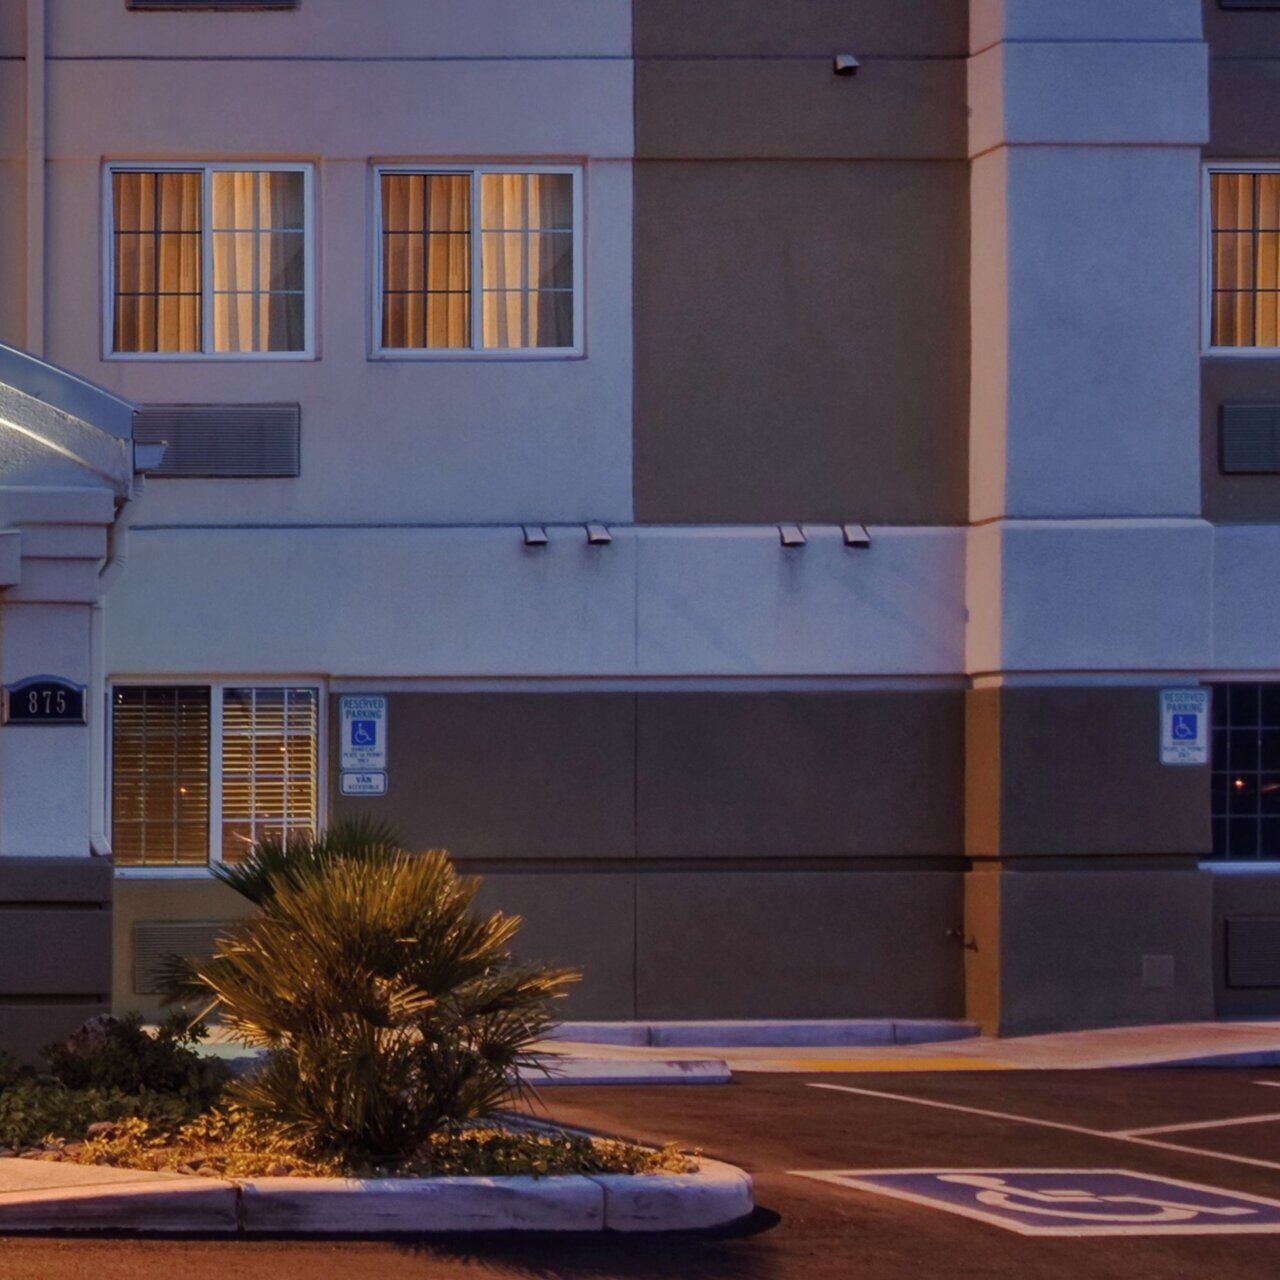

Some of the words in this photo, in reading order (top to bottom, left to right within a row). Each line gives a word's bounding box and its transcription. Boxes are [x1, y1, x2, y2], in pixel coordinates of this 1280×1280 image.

[28, 691, 65, 714] 875
[1164, 693, 1205, 703] RESERVED
[343, 699, 384, 709] RESERVED
[1166, 703, 1203, 713] PARKING
[345, 709, 382, 719] PARKING
[355, 776, 372, 784] VAN
